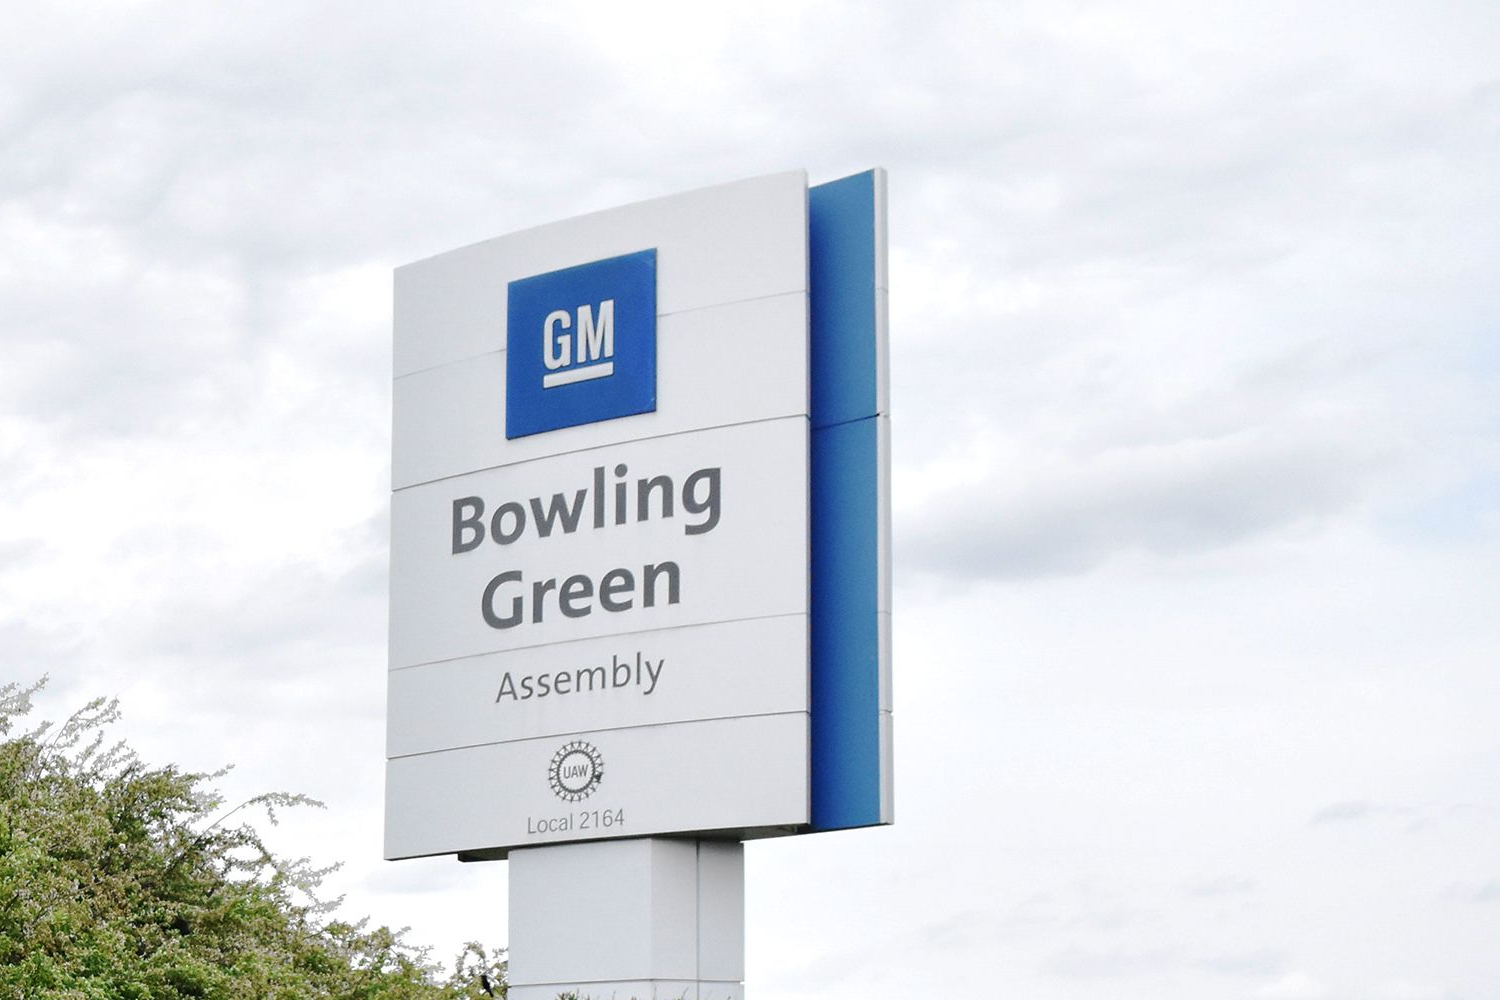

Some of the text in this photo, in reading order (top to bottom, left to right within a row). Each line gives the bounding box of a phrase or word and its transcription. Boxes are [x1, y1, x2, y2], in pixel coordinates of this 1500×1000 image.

[543, 299, 614, 370] GM
[452, 463, 722, 555] Bowling
[481, 561, 681, 630] Green
[495, 652, 665, 703] Assembly
[563, 764, 589, 779] UAW
[527, 808, 625, 834] Local 2164
